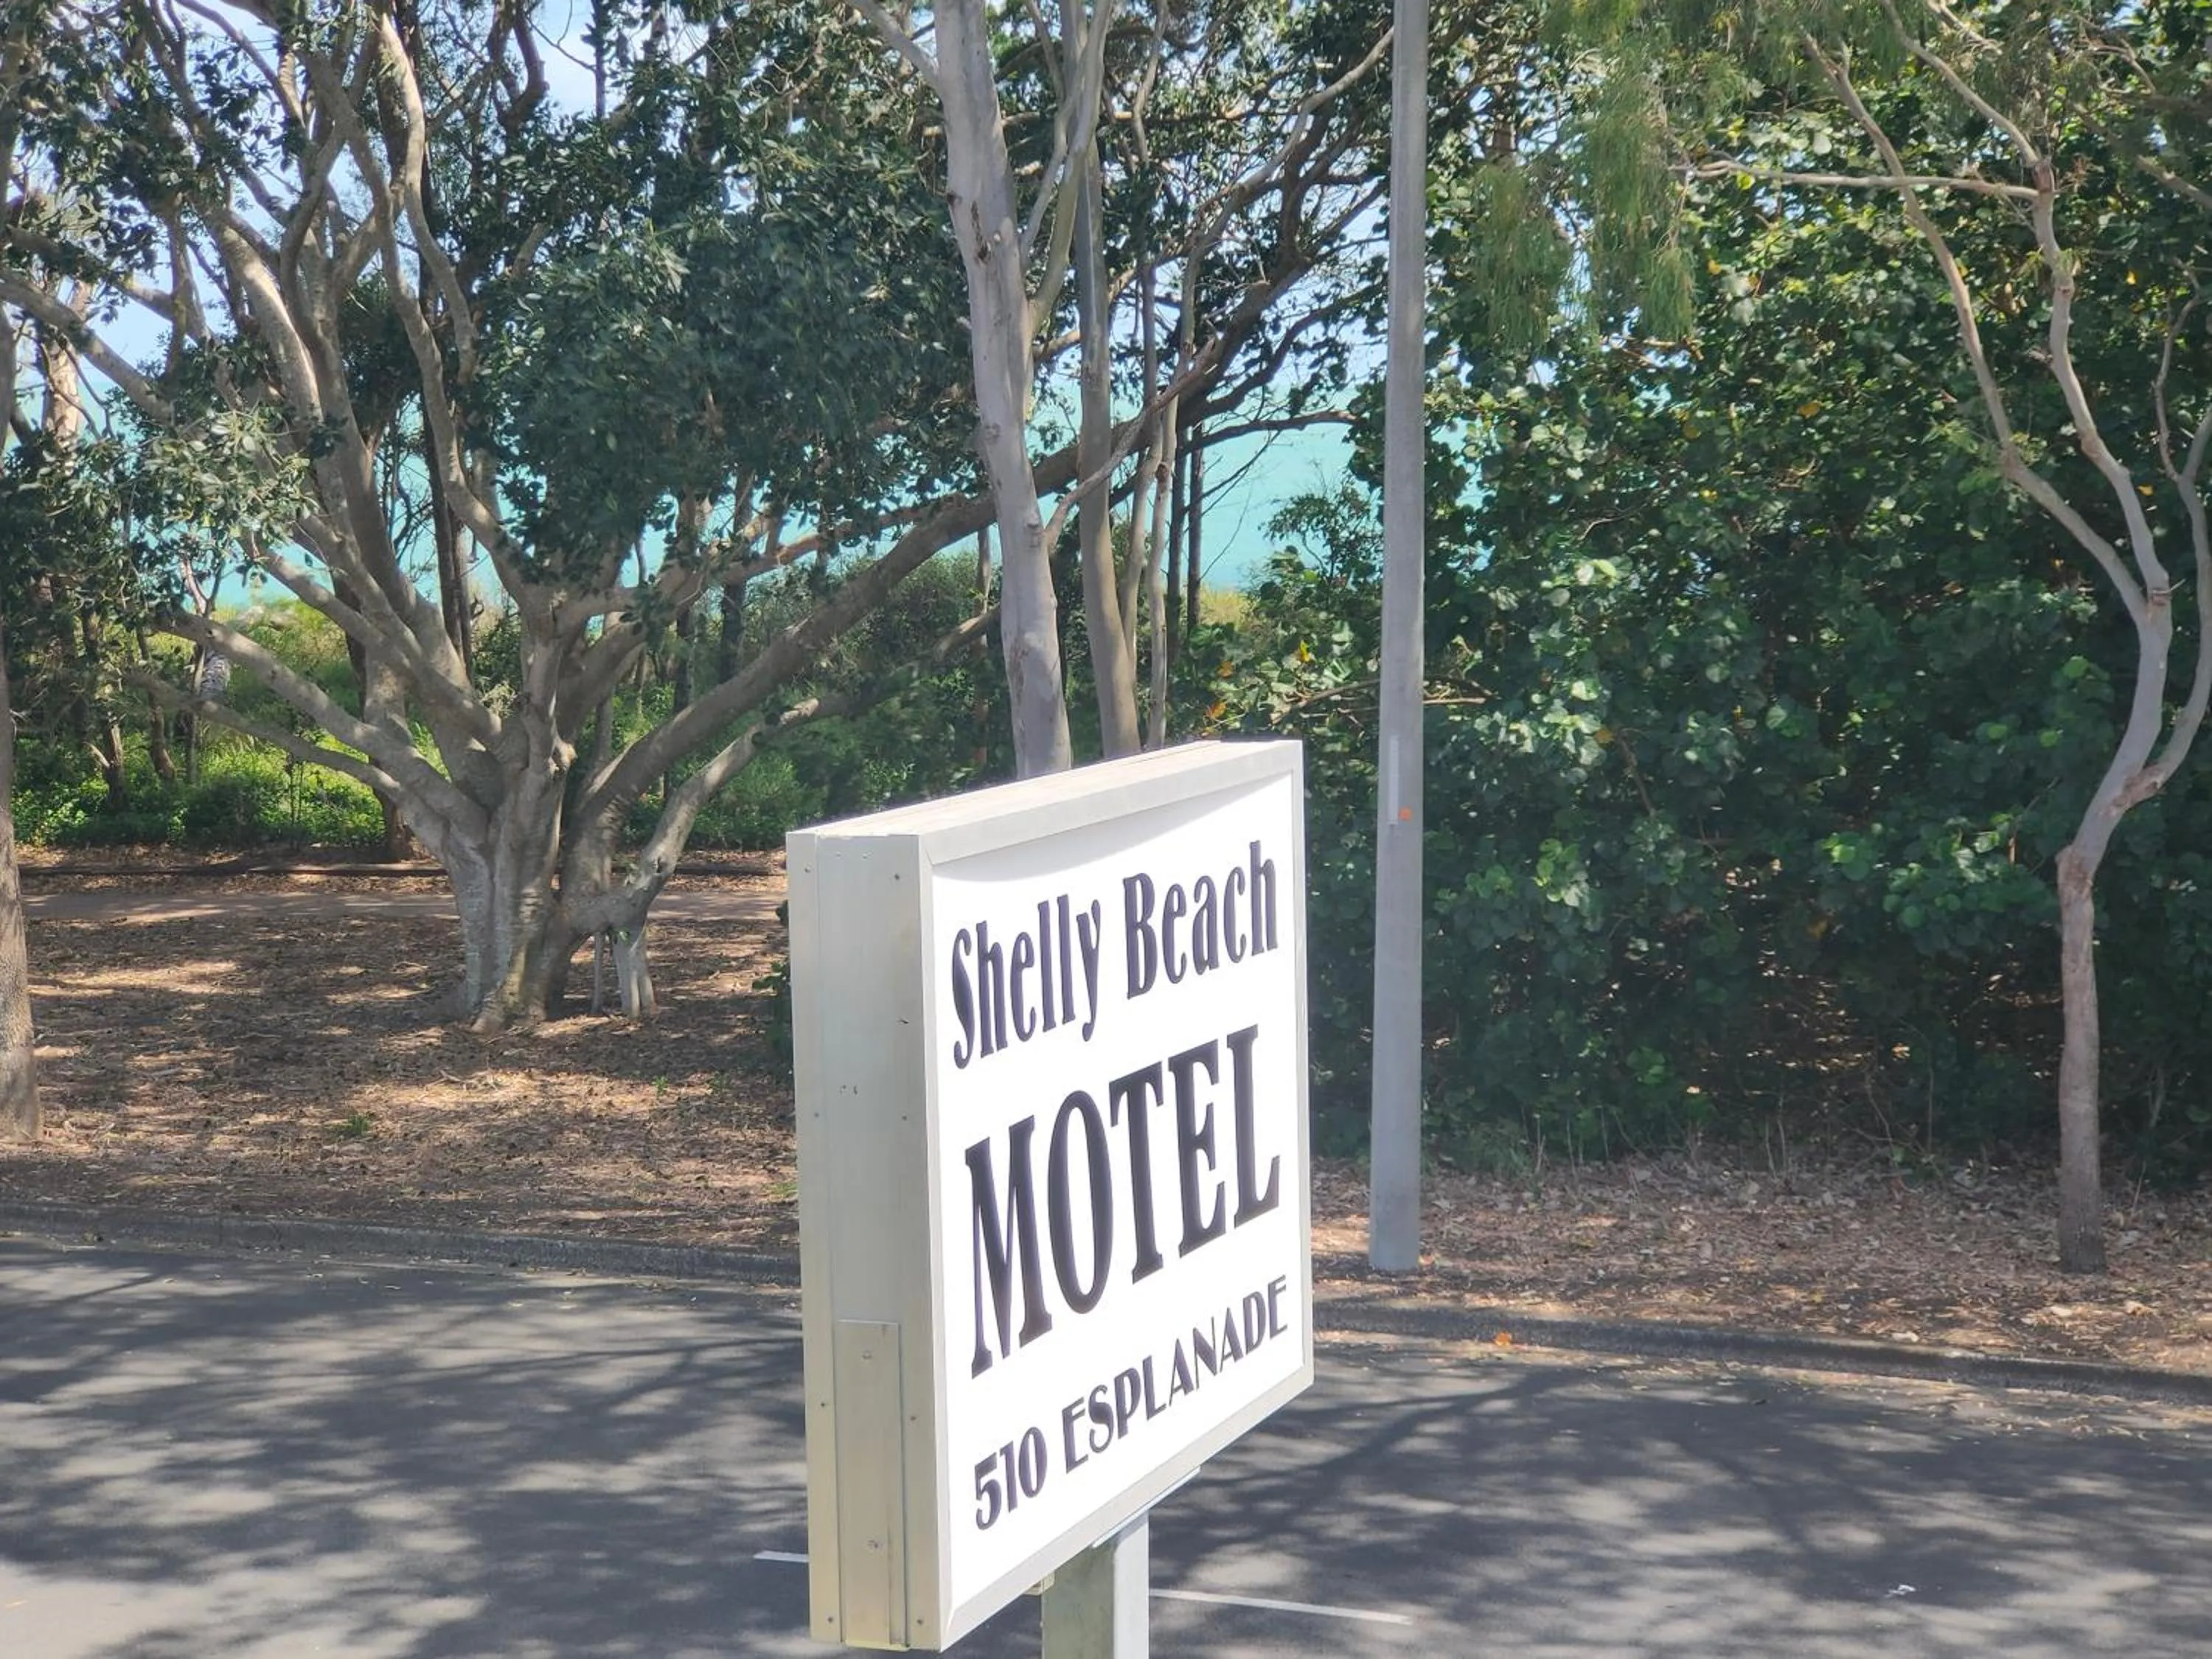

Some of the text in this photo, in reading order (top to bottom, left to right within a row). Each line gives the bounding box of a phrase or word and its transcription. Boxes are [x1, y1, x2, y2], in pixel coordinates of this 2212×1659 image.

[951, 840, 1278, 1070] Shelly Beach
[964, 1025, 1280, 1379] MOTEL
[974, 1276, 1288, 1531] 510 ESPLANADE
